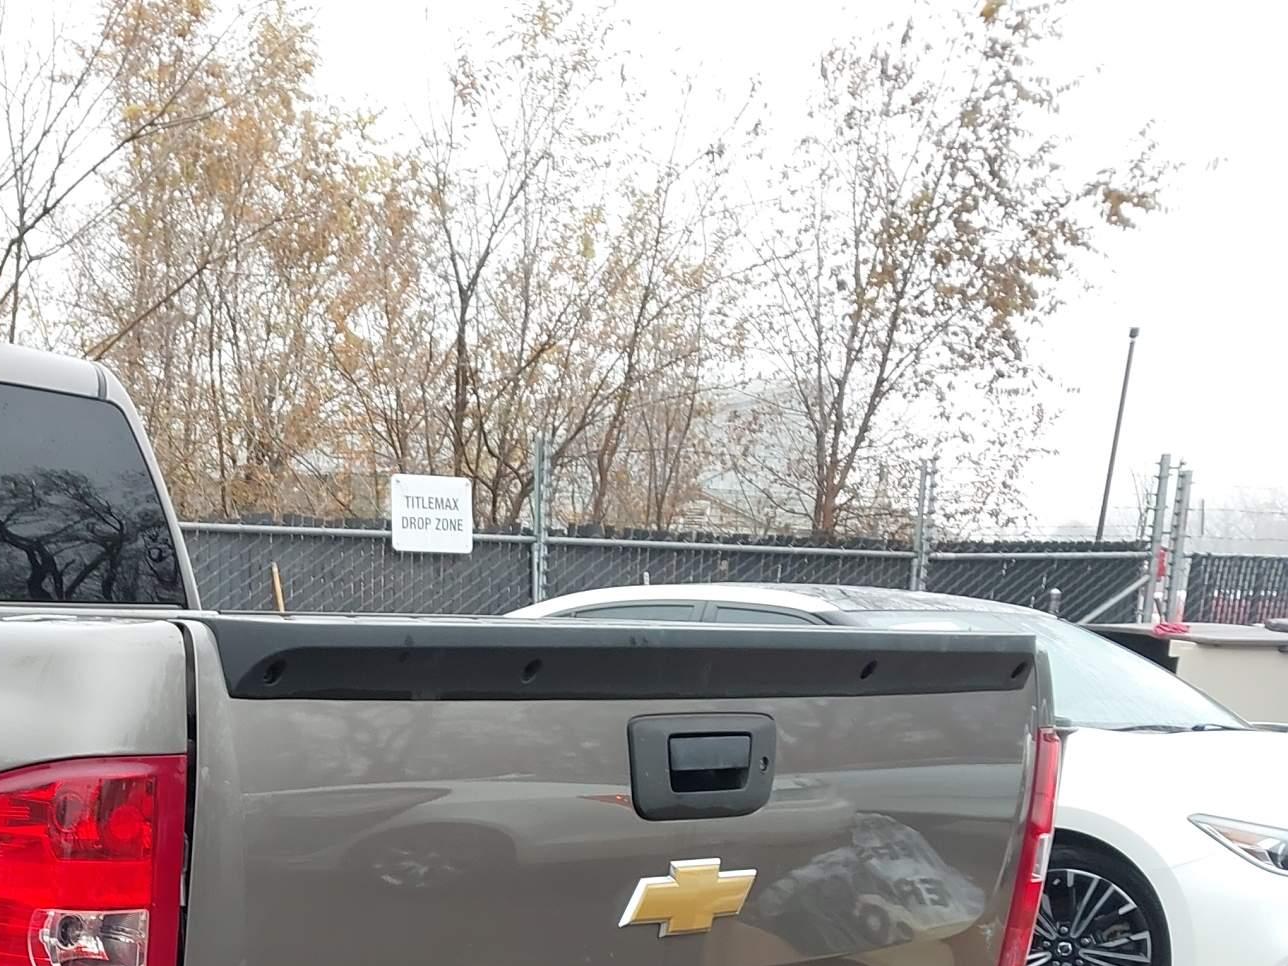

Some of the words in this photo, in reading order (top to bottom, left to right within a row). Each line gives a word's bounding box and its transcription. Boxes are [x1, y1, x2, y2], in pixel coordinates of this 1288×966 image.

[405, 495, 460, 511] TITLEMAX
[401, 516, 431, 530] DROP
[435, 517, 463, 531] ZONE
